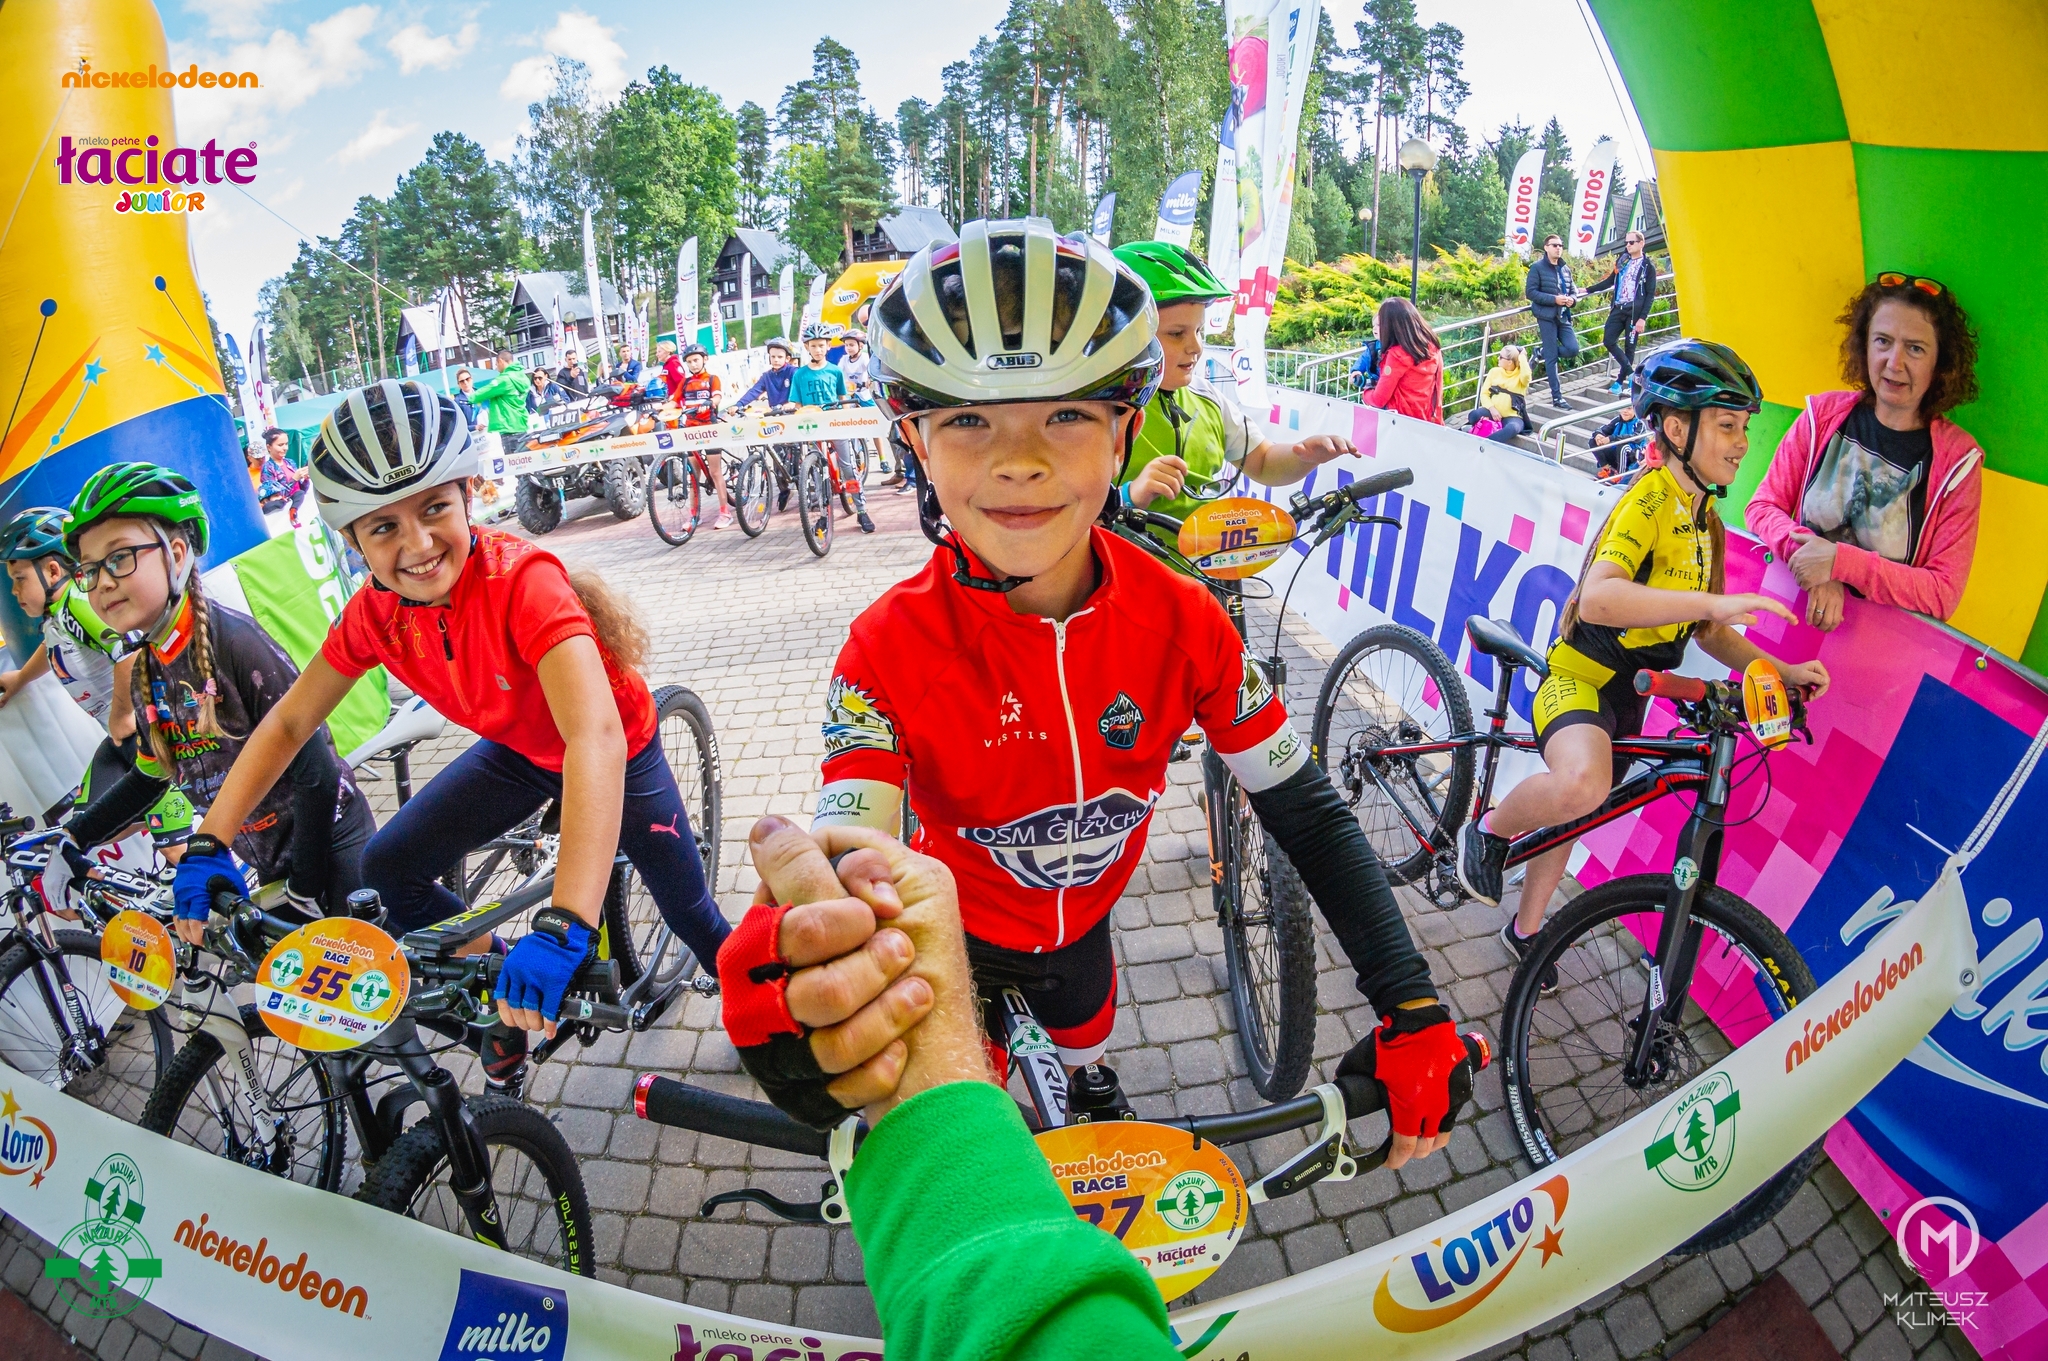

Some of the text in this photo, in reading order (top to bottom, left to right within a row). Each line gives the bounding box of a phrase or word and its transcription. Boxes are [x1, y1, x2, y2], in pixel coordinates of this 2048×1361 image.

[1276, 53, 1286, 79] JOGURT
[1166, 193, 1195, 208] milko
[1514, 175, 1533, 223] LOTOS
[1582, 169, 1605, 220] LOTOS
[1160, 227, 1180, 236] MILKO
[994, 355, 1036, 367] ABUS
[552, 411, 578, 427] PILOT
[763, 424, 780, 435] LOTTO
[829, 418, 878, 428] nickelodeon
[388, 467, 413, 482] ABUS
[1636, 491, 1660, 508] HOTEL
[1209, 509, 1261, 521] nickelodeon
[1225, 518, 1247, 527] RACE
[1220, 527, 1259, 551] 105
[1765, 695, 1777, 716] 46
[984, 731, 1048, 748] VESTIS
[974, 827, 1035, 845] OSM
[132, 936, 147, 948] RACE
[312, 934, 375, 959] nickelodeon
[129, 949, 147, 973] 10
[323, 950, 351, 965] RACE
[301, 965, 353, 1002] 55
[1785, 942, 1923, 1074] nickelodeon
[238, 1048, 263, 1101] MISSION
[1677, 1080, 1721, 1115] MAZURY
[1508, 1084, 1544, 1164] CROSSMARK
[2, 1122, 43, 1163] LOTTO
[109, 1163, 136, 1186] MAZURY
[1294, 1162, 1322, 1183] SHIMANO
[1694, 1155, 1718, 1180] MTB
[1072, 1175, 1127, 1194] RACE
[1175, 1177, 1205, 1190] MAZURY
[558, 1191, 576, 1238] VOLAR
[1183, 1216, 1200, 1226] MTB
[1157, 1243, 1207, 1263] łaciate
[1411, 1196, 1534, 1303] LOTTO
[173, 1213, 369, 1318] nickelodeon
[458, 1312, 551, 1352] milko
[703, 1328, 747, 1343] mleko
